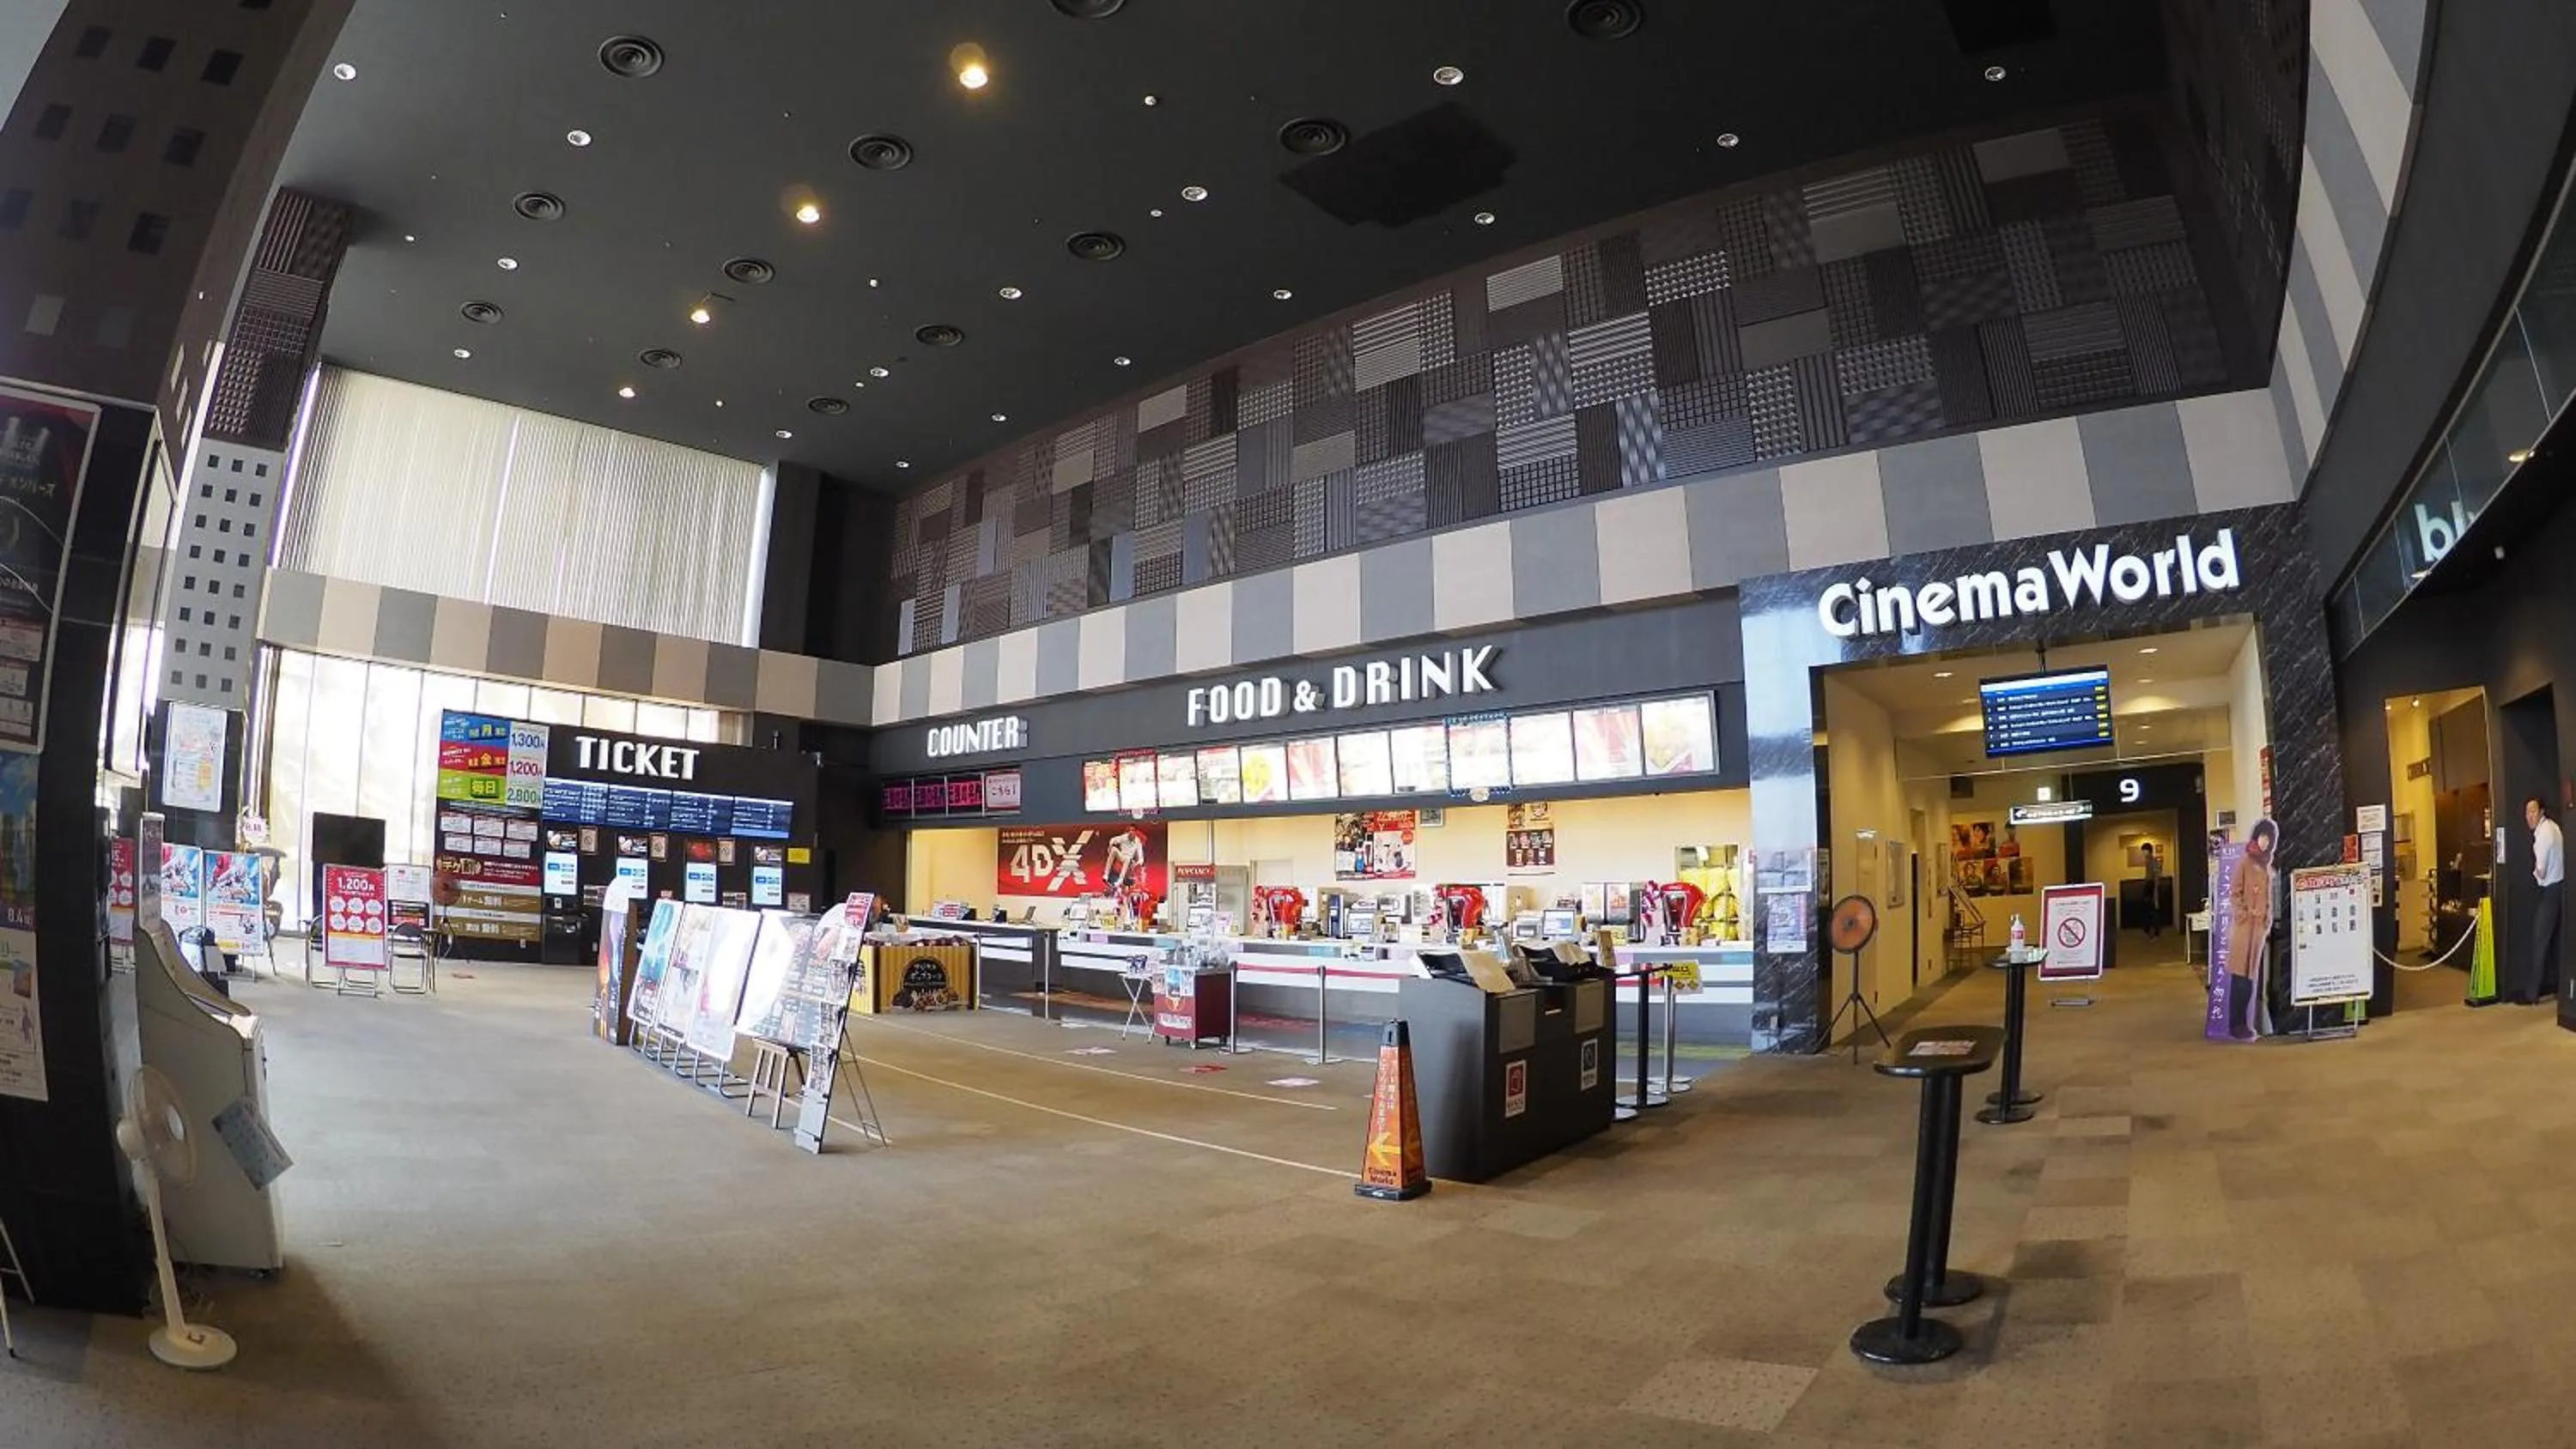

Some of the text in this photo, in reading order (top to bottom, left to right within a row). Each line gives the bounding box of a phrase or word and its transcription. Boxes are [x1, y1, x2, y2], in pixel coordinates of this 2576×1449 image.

[1818, 529, 2241, 637] CinemaWorld
[1187, 645, 1501, 726] FOOD & DRINK
[575, 736, 700, 779] TICKET
[927, 715, 1028, 757] COUNTER
[2119, 778, 2141, 802] 9
[1010, 829, 1095, 892] 4DX
